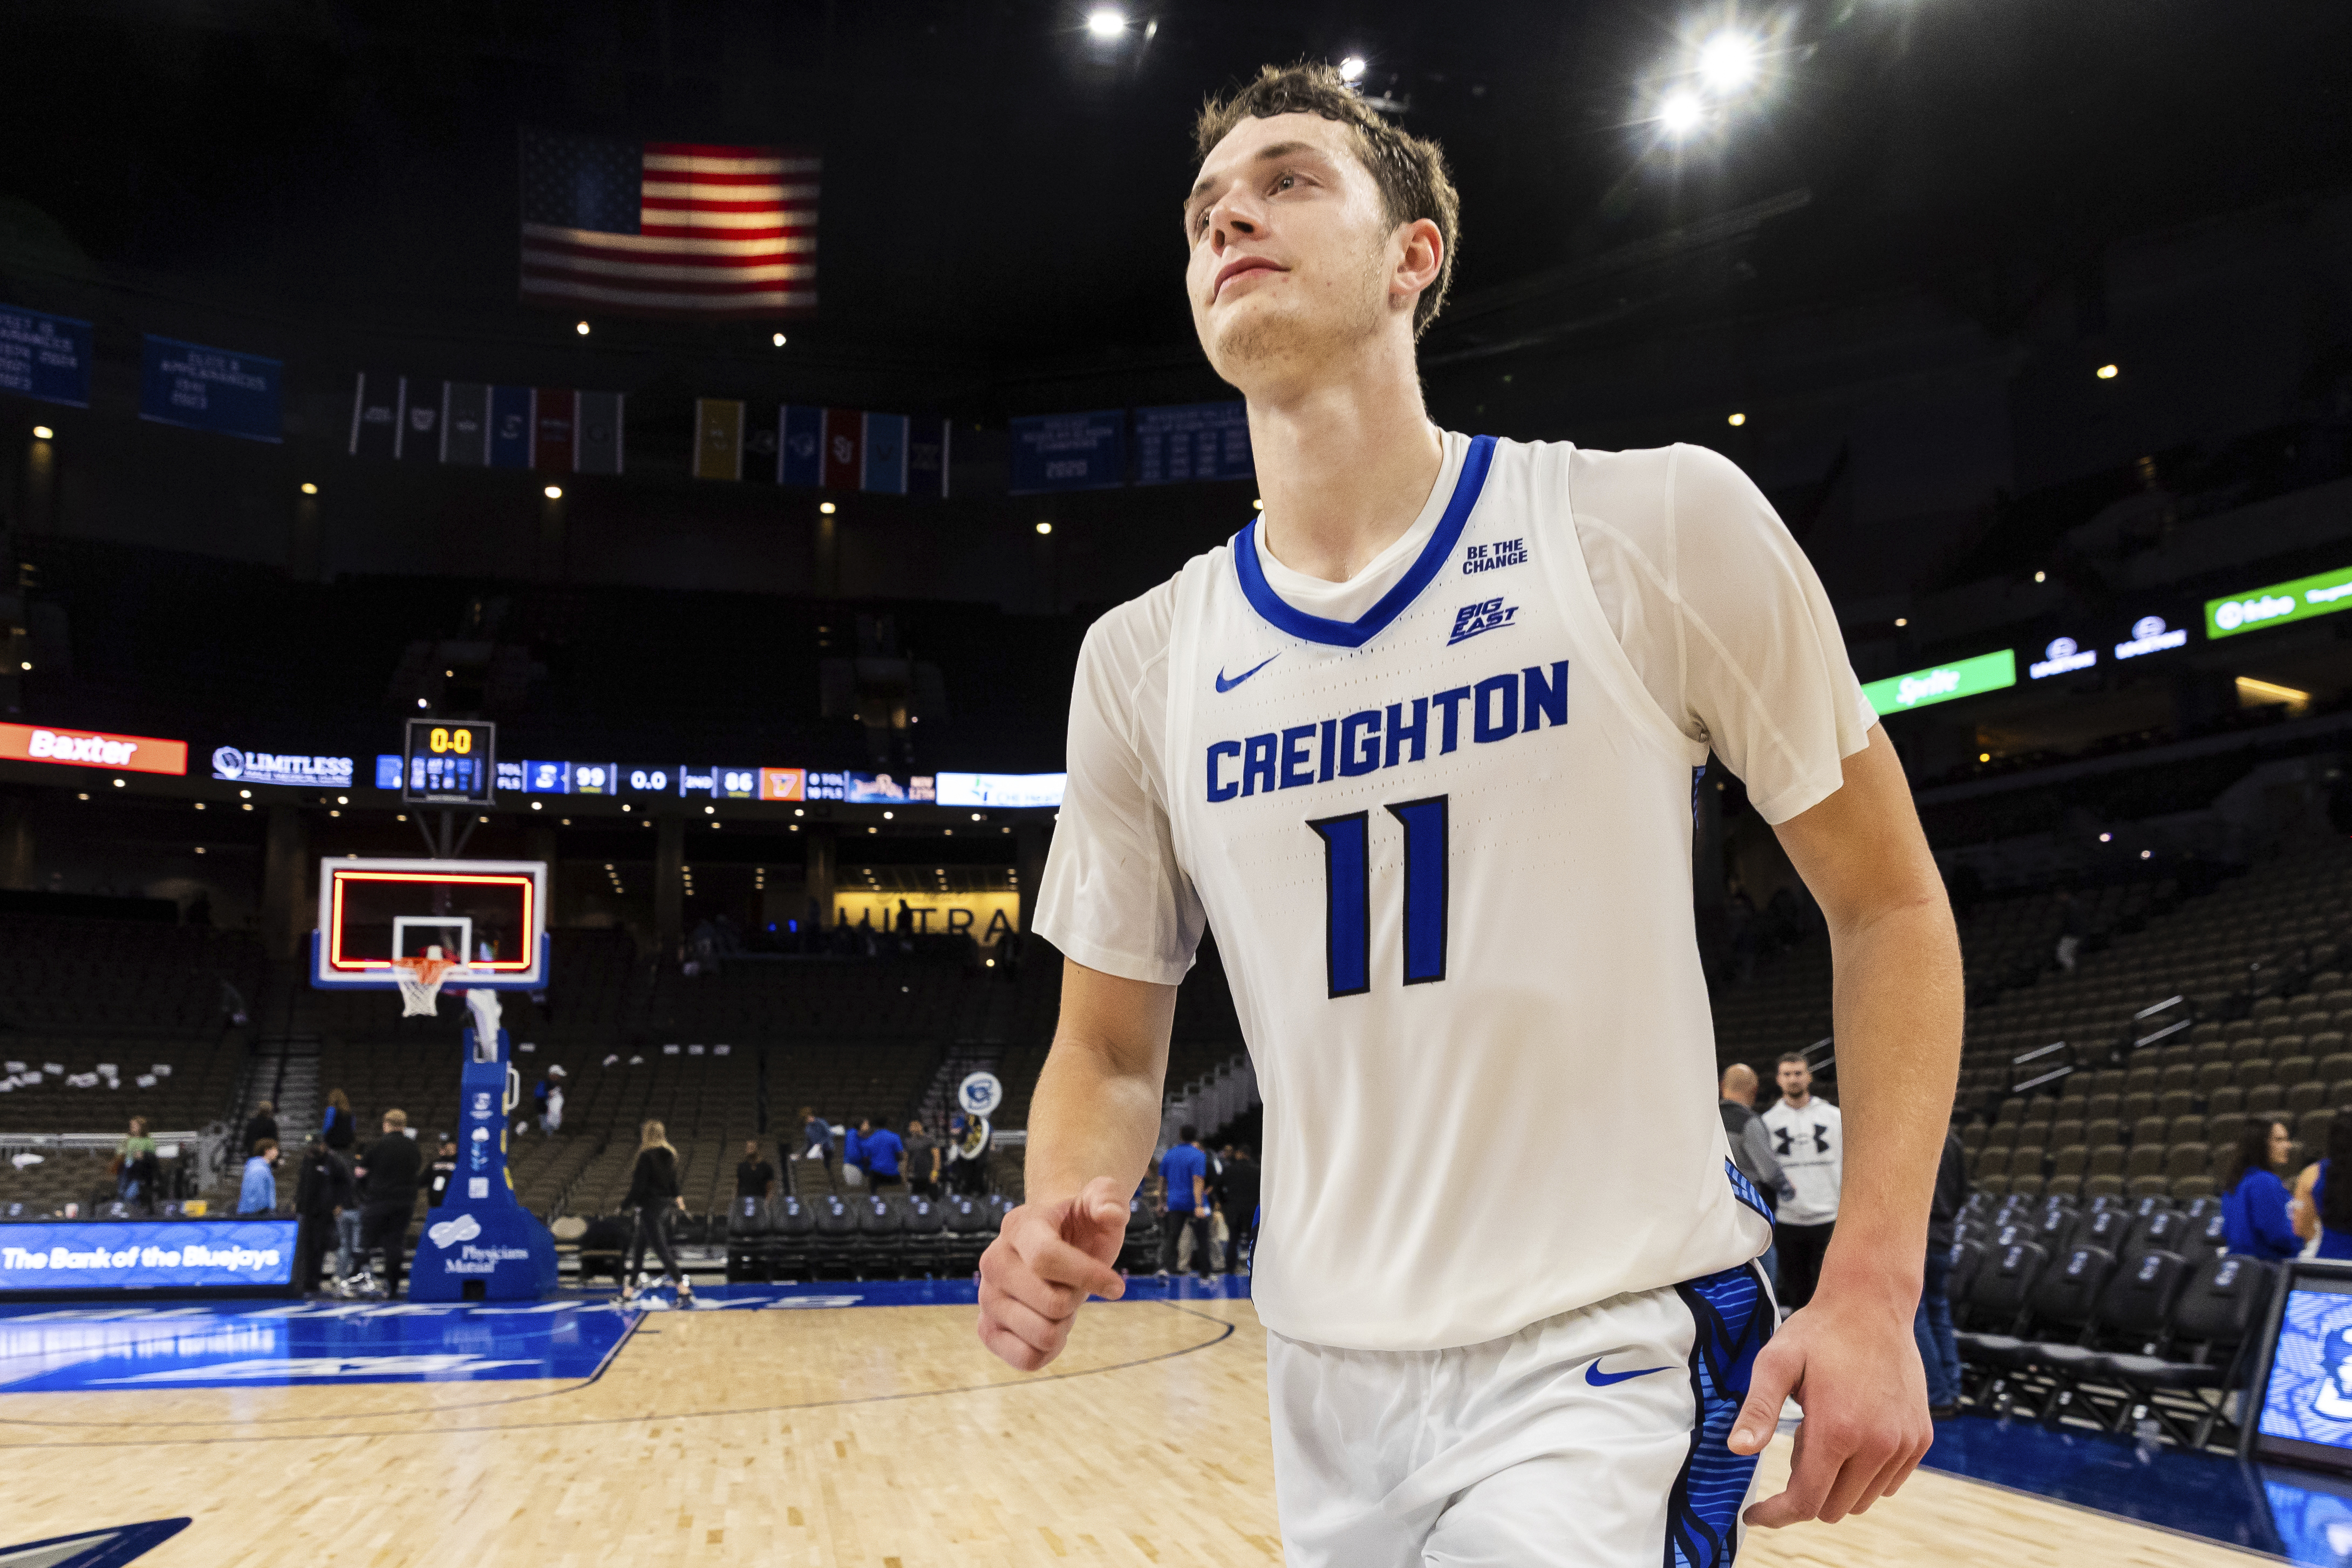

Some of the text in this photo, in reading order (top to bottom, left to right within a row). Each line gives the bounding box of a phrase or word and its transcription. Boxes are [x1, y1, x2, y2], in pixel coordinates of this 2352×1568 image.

[1467, 538, 1523, 560] BE THE
[1462, 550, 1528, 575] CHANGE
[1456, 596, 1504, 622] BIG
[1450, 606, 1519, 638] EAST
[1896, 669, 1960, 706] Sprite
[1206, 659, 1569, 802] CREIGHTON
[29, 730, 138, 766] Baxter
[245, 752, 353, 776] LIMITLESS
[576, 767, 605, 788] 99
[630, 771, 667, 790] 0.0
[724, 772, 754, 792] 86
[1305, 793, 1449, 999] 11
[2, 1245, 279, 1271] The Bank of the Bluejays
[445, 1258, 495, 1273] Mutual
